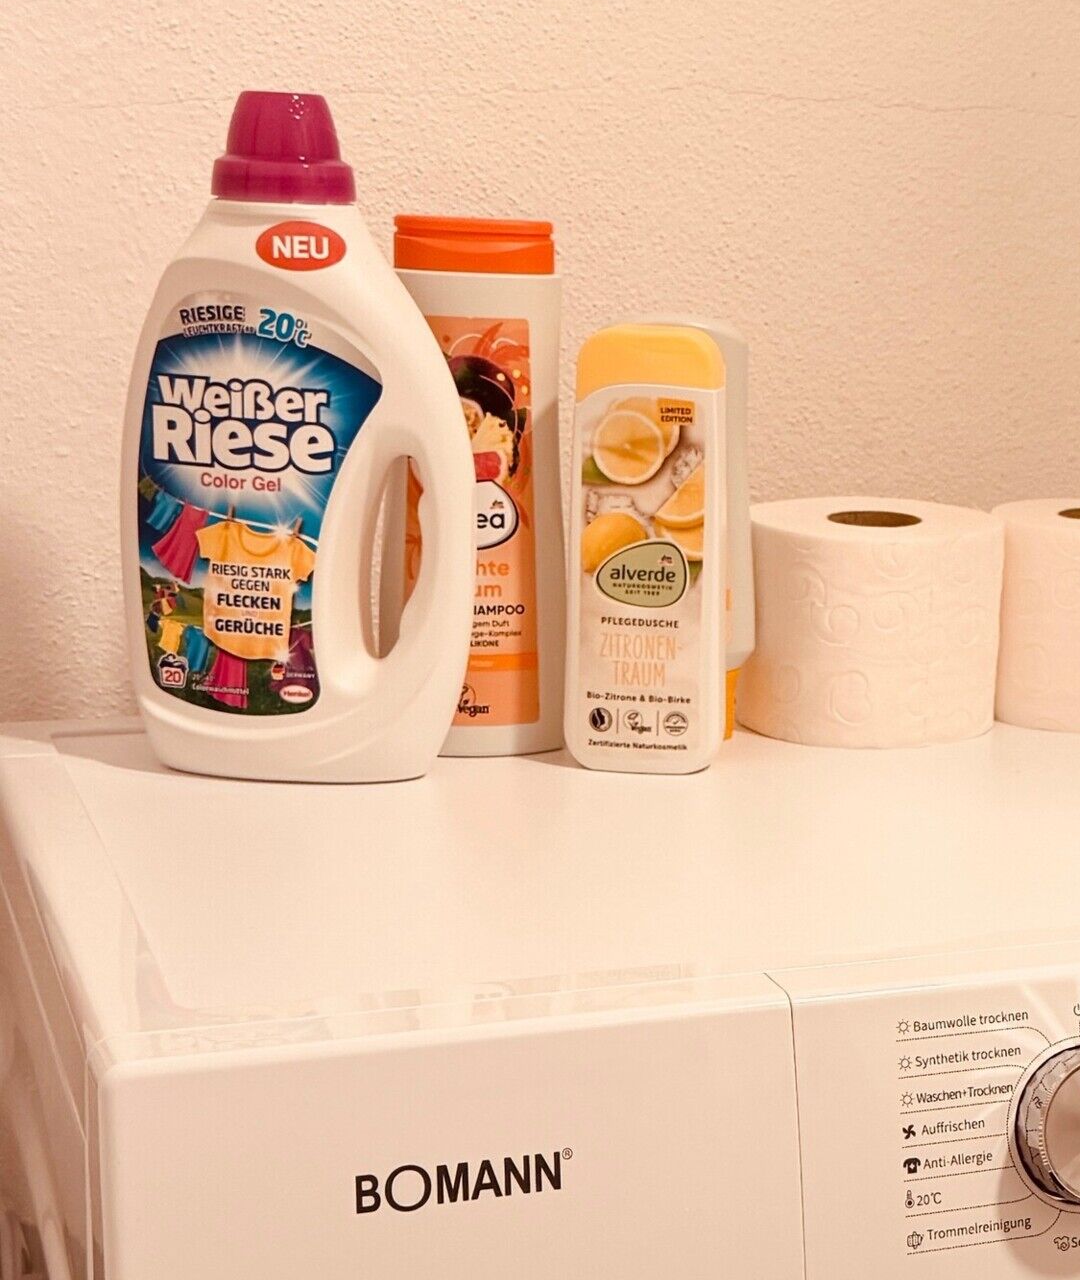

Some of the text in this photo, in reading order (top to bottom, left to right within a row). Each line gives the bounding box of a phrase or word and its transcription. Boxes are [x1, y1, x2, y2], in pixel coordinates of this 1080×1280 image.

[272, 235, 330, 260] NEU
[180, 305, 245, 325] RIESIGE
[157, 374, 330, 424] Weißer
[660, 407, 691, 415] LIMITED
[660, 415, 693, 423] EDITION
[152, 402, 335, 474] Riese
[200, 472, 282, 492] Color Gel
[212, 563, 291, 580] RIESIG STARK
[610, 564, 676, 582] alverde
[231, 578, 270, 592] GEGEN
[217, 593, 281, 610] FLECKEN
[474, 604, 525, 615] AMPOO
[215, 618, 284, 636] GERÜCHE
[601, 616, 680, 629] PFLEGEDUSCHE
[600, 632, 683, 660] ZITRONEN-
[164, 670, 181, 683] 20
[612, 660, 666, 688] TRAUM
[587, 691, 637, 702] Bio-Zitrone
[649, 695, 691, 704] Bio-Birke
[588, 739, 687, 751] Zertifizierte Naturkosmetik
[913, 1010, 1029, 1033] Baumwolle trocknen
[915, 1045, 1022, 1069] Synthetik trocknen
[916, 1083, 1014, 1104] Waschen+Trocknen
[921, 1118, 986, 1136] Auffrischen
[923, 1151, 993, 1170] Anti-Allergie
[916, 1191, 942, 1207] 20°C
[927, 1217, 1032, 1241] Trommelreinigung
